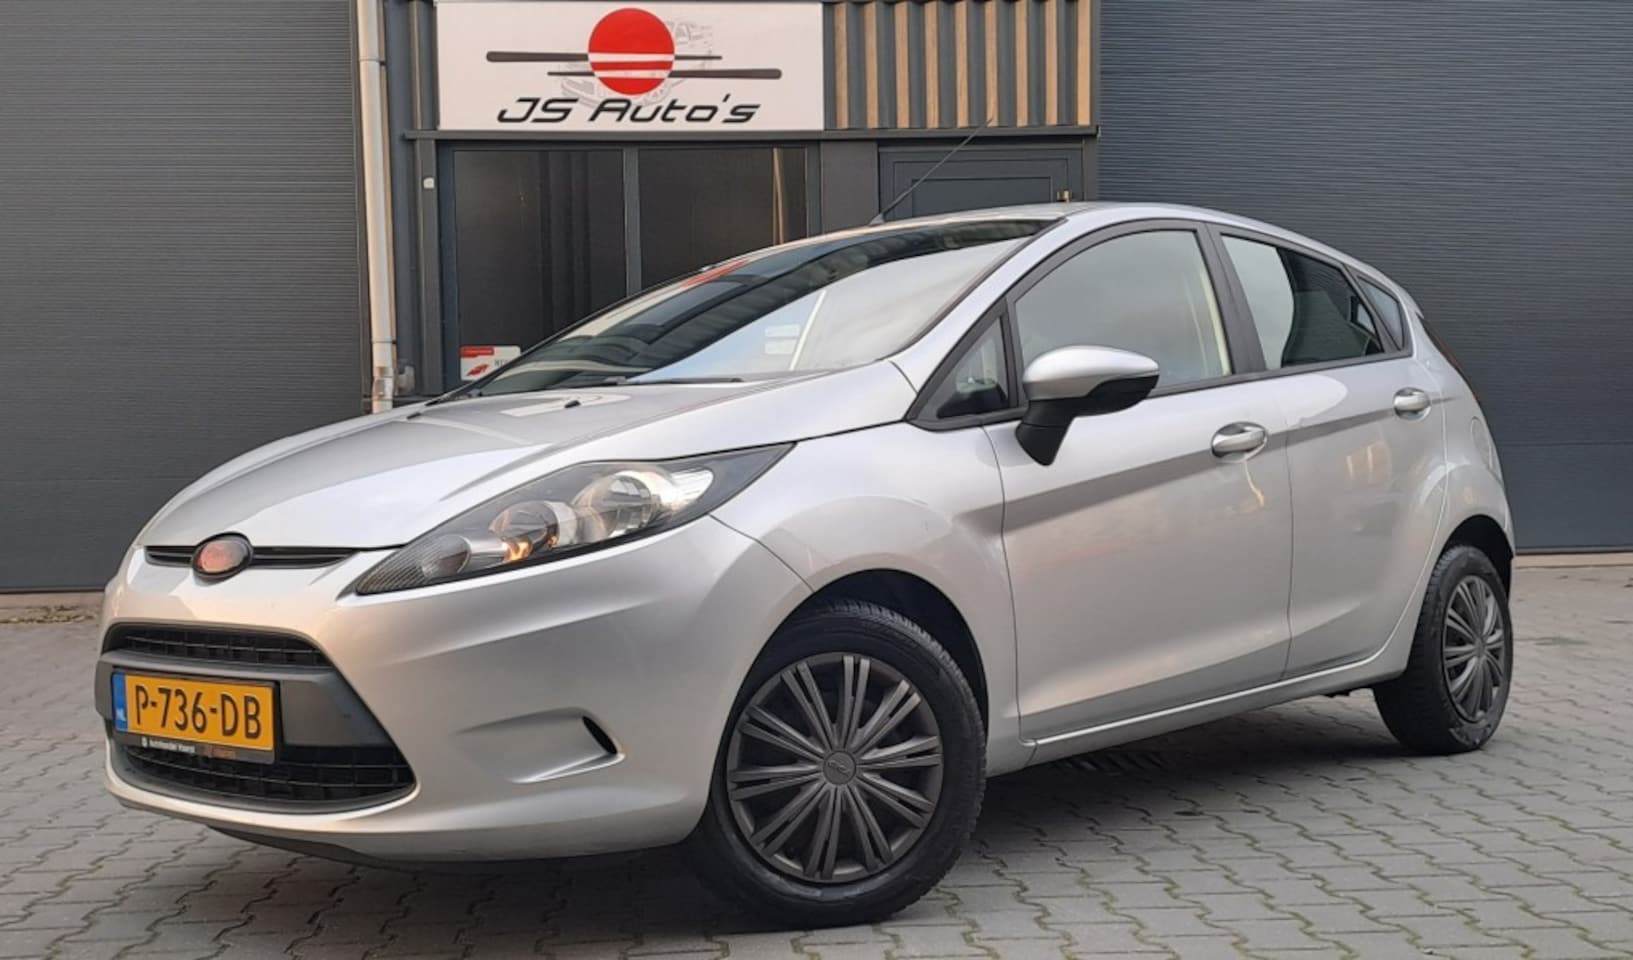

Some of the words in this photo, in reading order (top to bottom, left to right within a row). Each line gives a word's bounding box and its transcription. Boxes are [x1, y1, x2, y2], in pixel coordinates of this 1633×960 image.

[497, 97, 578, 123] JS
[588, 93, 761, 123] Auto's
[135, 685, 261, 738] P-736-DB
